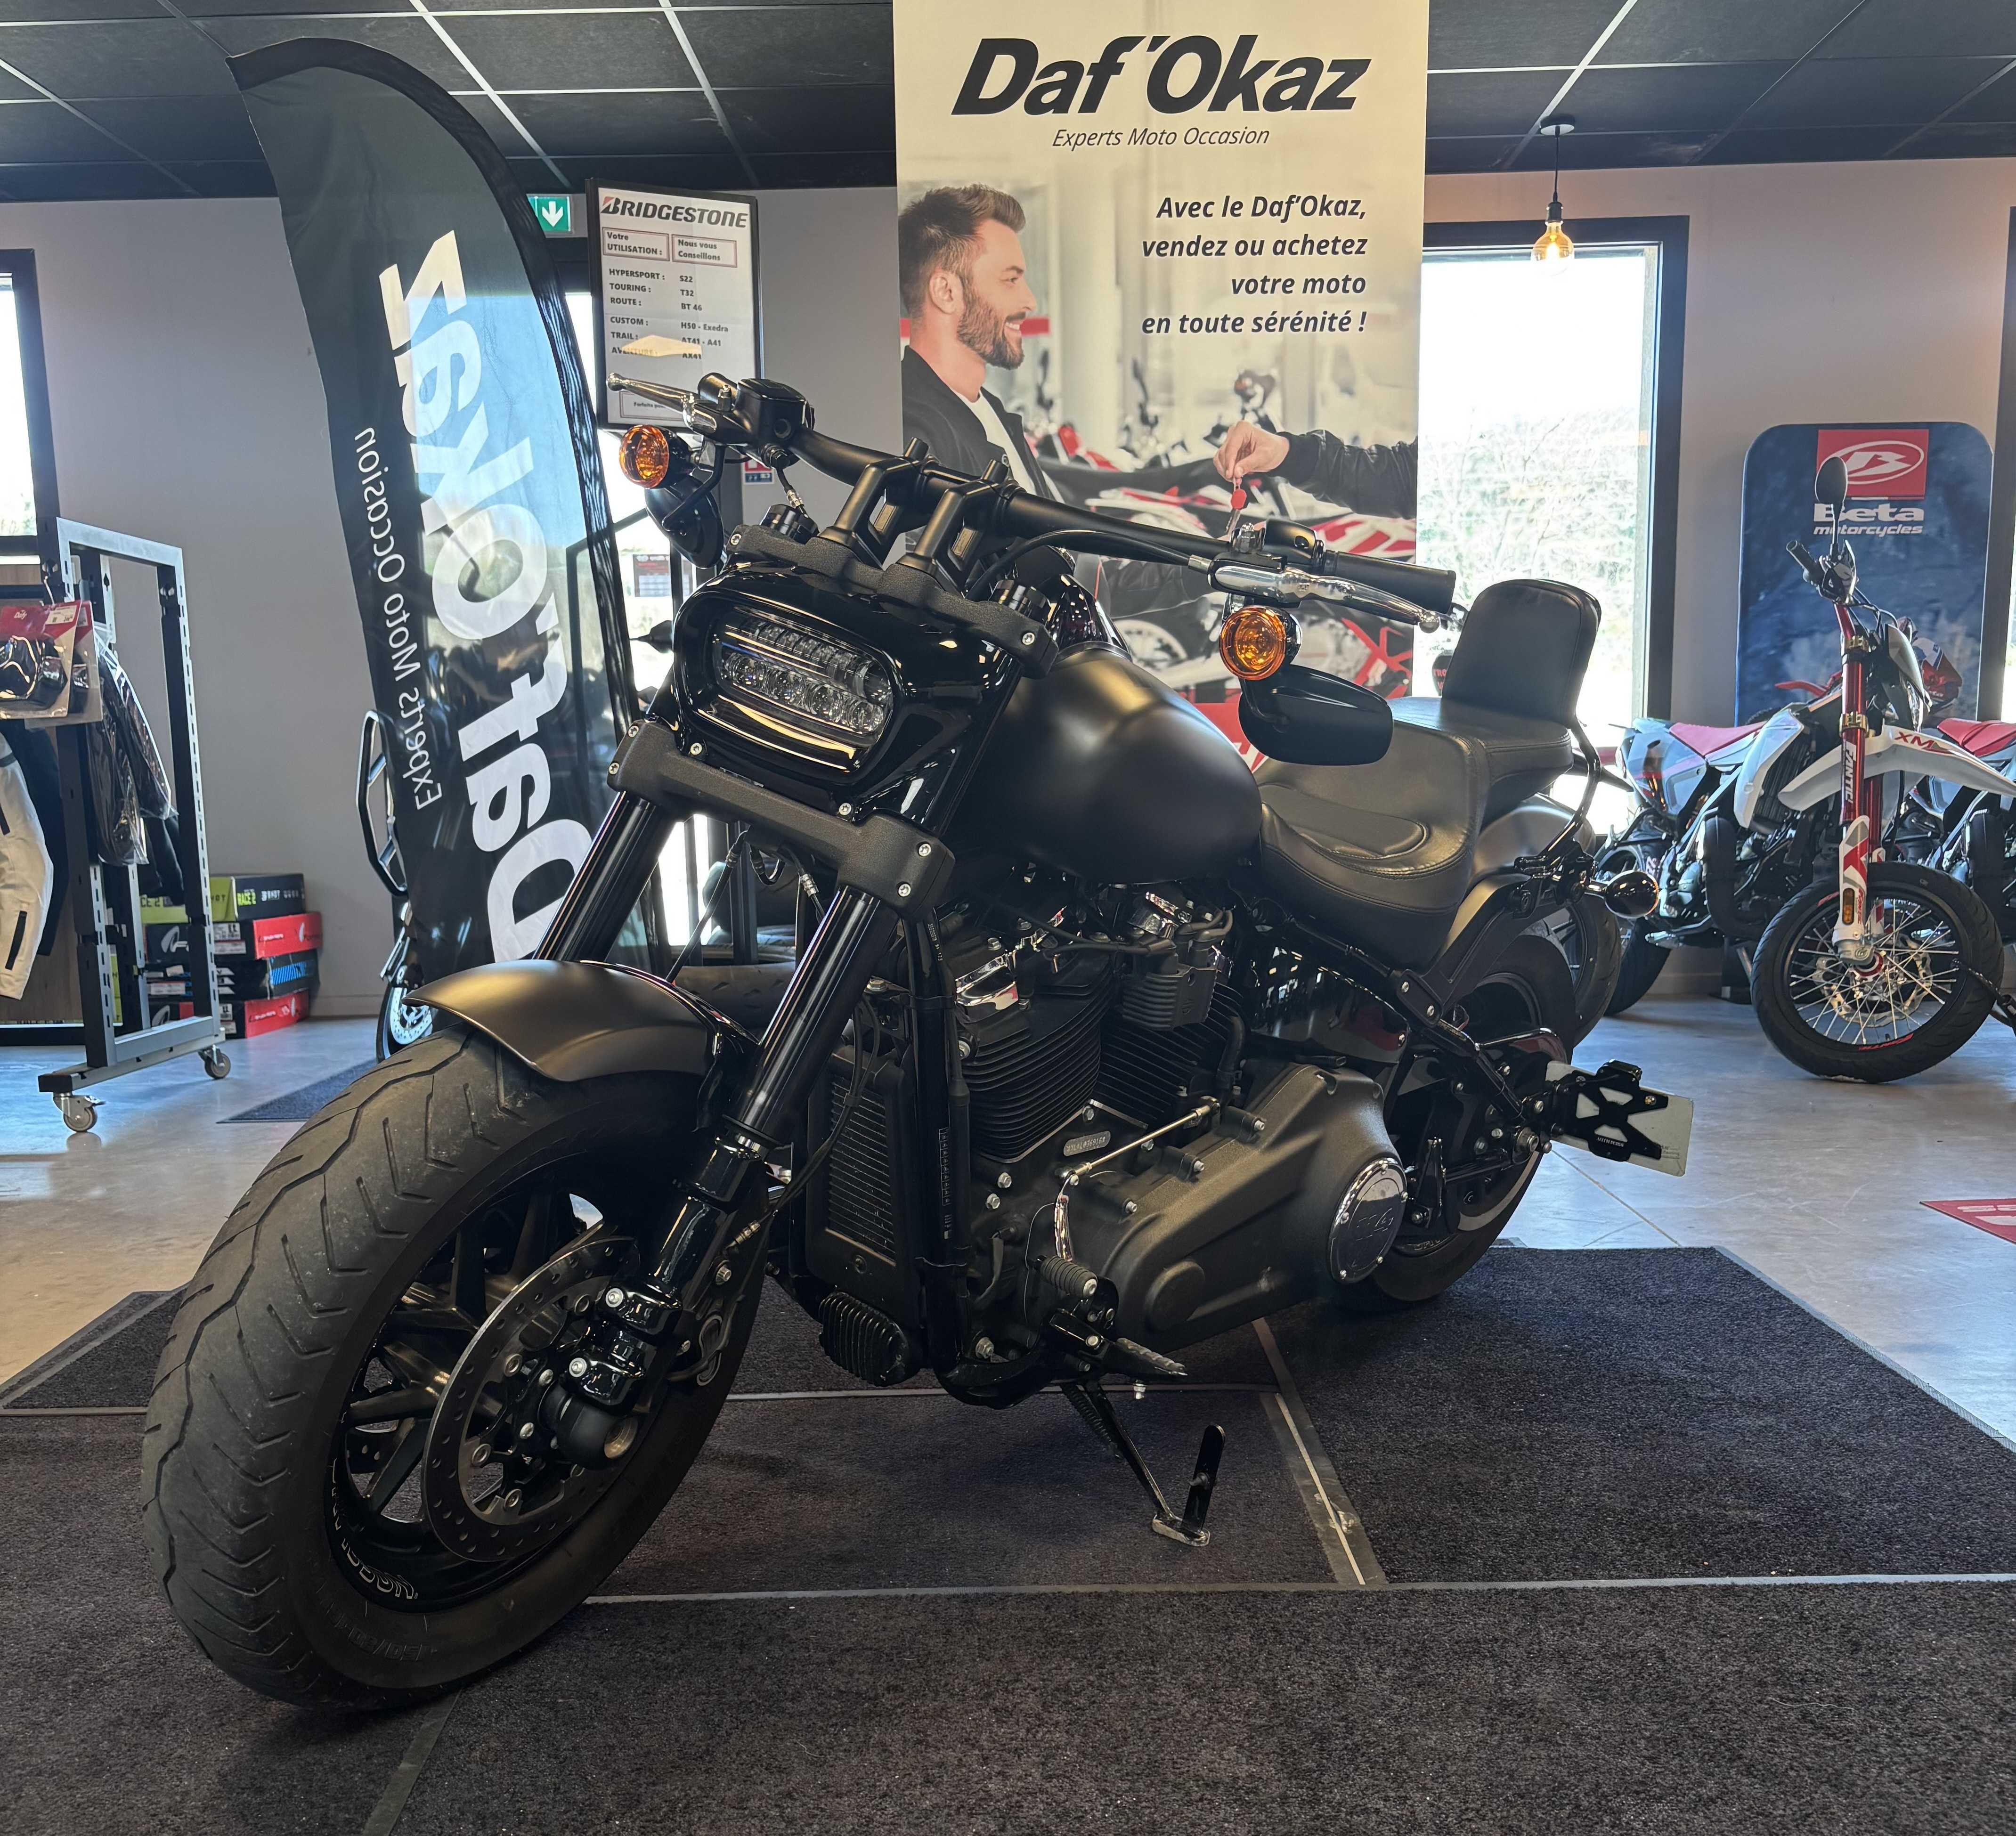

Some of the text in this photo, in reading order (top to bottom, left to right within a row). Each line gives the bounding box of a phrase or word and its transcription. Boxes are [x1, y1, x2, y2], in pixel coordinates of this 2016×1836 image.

[1053, 127, 1269, 151] Experts Moto Occasion
[601, 196, 748, 227] BRIDGESTONE
[1156, 198, 1214, 218] Avec
[1222, 196, 1243, 217] le
[607, 232, 629, 241] Votre
[678, 239, 697, 247] Nous
[1143, 234, 1367, 257] vendez ou achetez
[607, 244, 658, 255] UTILISATION
[678, 251, 721, 261] Conseillons
[609, 268, 660, 279] HYPERSPORT
[610, 283, 647, 292] TOURING
[1232, 275, 1365, 294] votre moto
[610, 297, 637, 306] ROUTE
[610, 317, 644, 325] CUSTOM
[1143, 318, 1170, 333] en
[1179, 315, 1244, 333] toute
[1252, 310, 1351, 332] sérénité
[703, 324, 728, 332] Exedra
[611, 332, 634, 340] TRAIL
